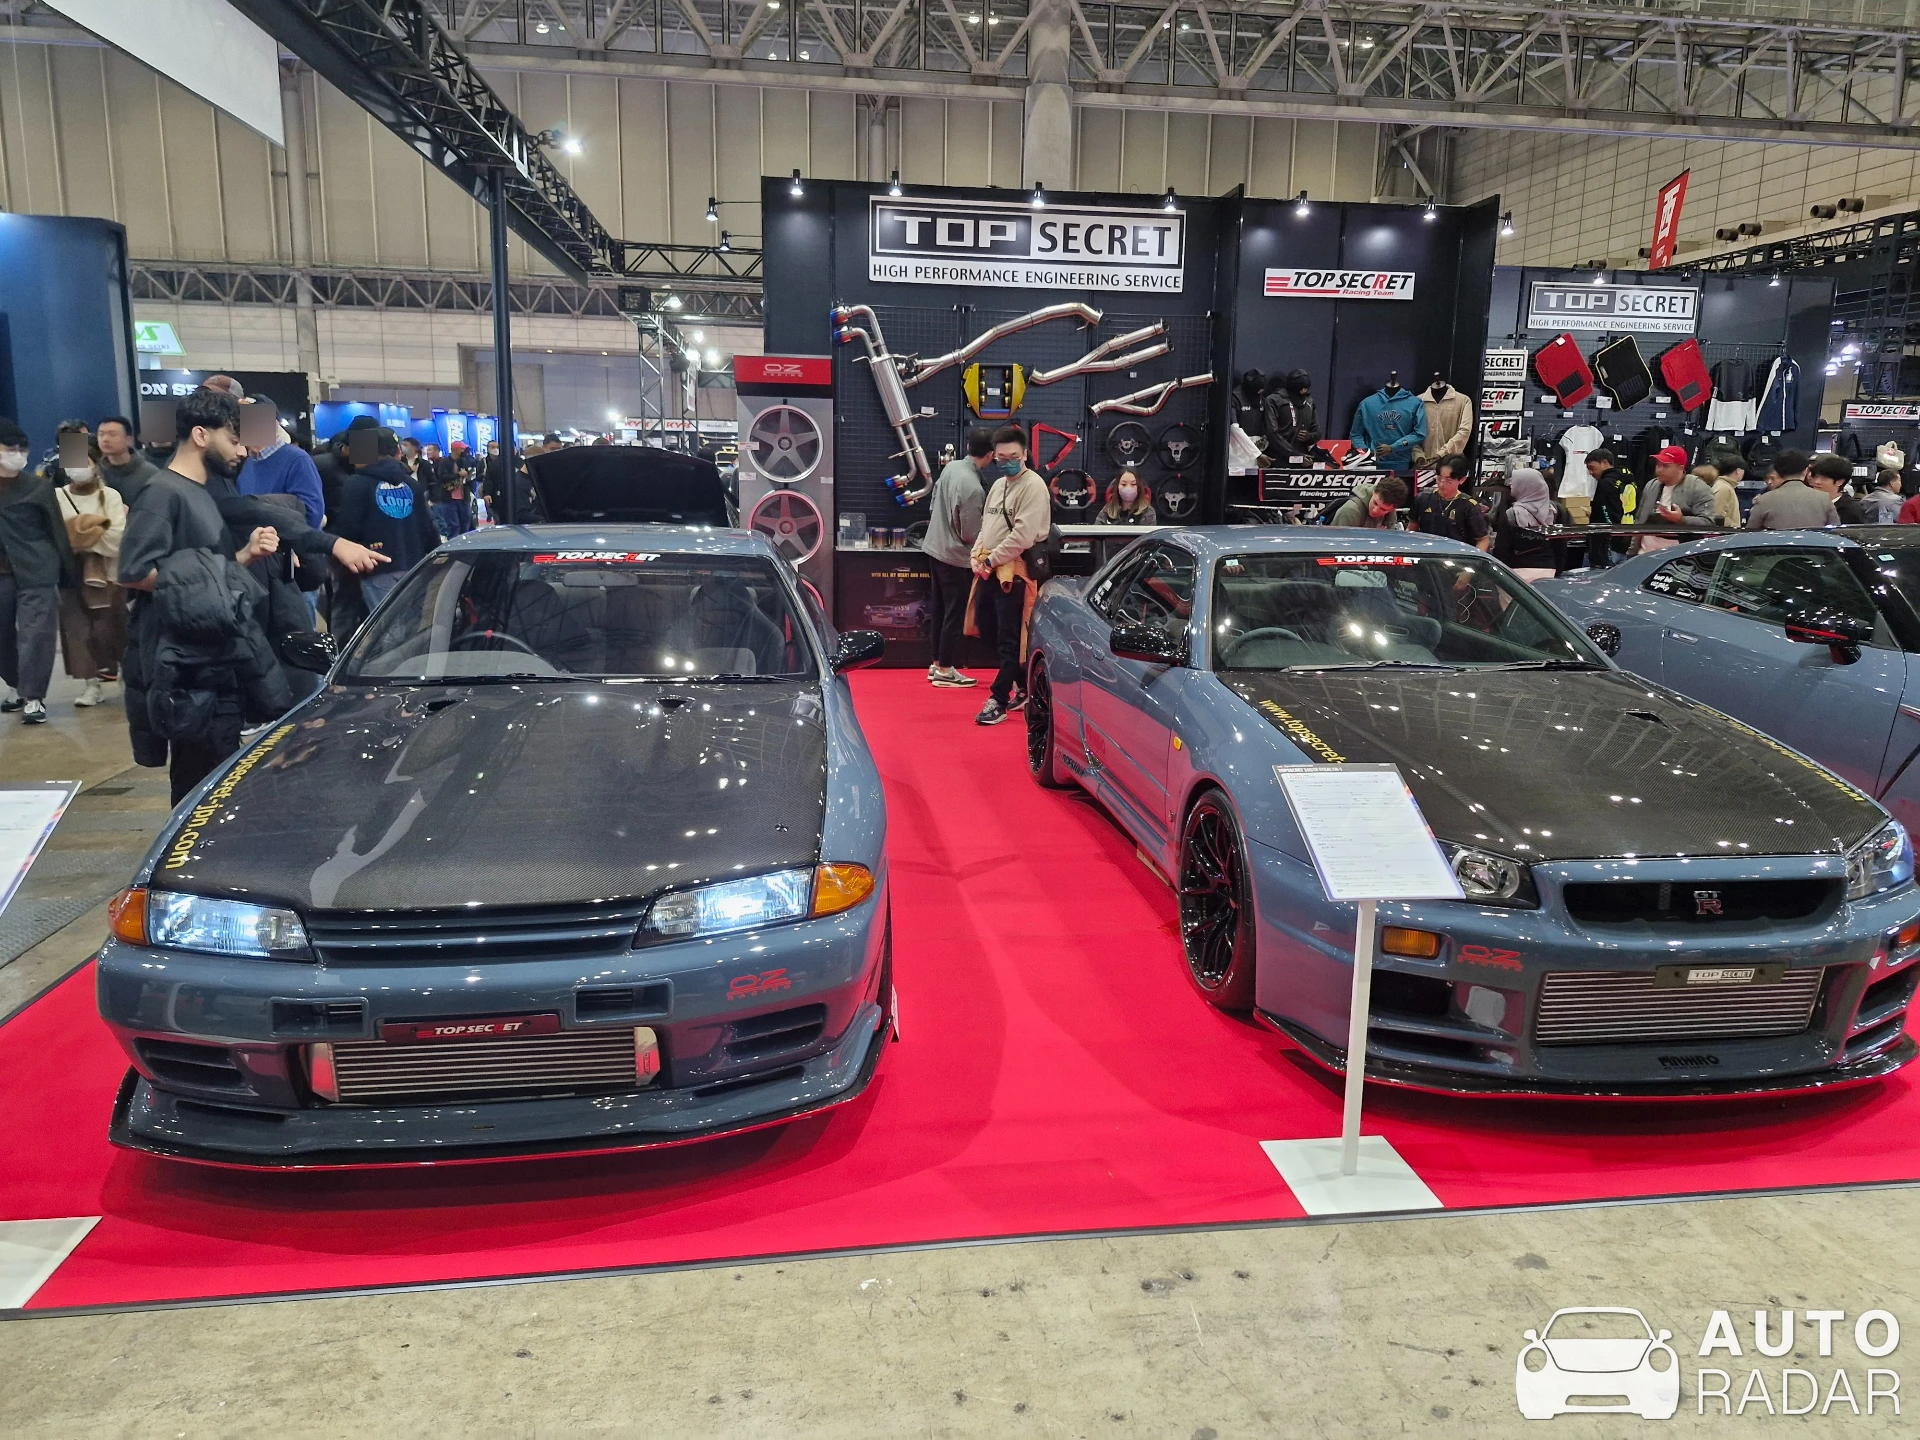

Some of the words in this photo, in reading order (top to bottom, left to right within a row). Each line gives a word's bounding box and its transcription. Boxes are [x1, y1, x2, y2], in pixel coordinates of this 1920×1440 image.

[1657, 183, 1681, 245] 西
[894, 216, 1017, 248] TOP
[1037, 221, 1172, 257] SECRET
[873, 264, 908, 278] HIGH
[915, 266, 1020, 283] PERFORMANCE
[1026, 271, 1120, 287] ENGINEERING
[1124, 274, 1181, 289] SERVICE
[1342, 289, 1371, 297] Racing
[1543, 291, 1609, 310] TOP
[1618, 294, 1690, 314] SECRET
[1530, 319, 1549, 327] HIGH
[1552, 320, 1608, 329] PERFORMANCE
[1610, 321, 1661, 330] ENGINEERING
[1662, 323, 1693, 331] SERVICE
[1289, 474, 1327, 487] TOP
[1300, 490, 1328, 498] Racing
[165, 723, 296, 869] www.topsecret-jpn.com
[1696, 899, 1723, 915] R
[1721, 970, 1752, 978] SECRET
[435, 1026, 467, 1035] TOP
